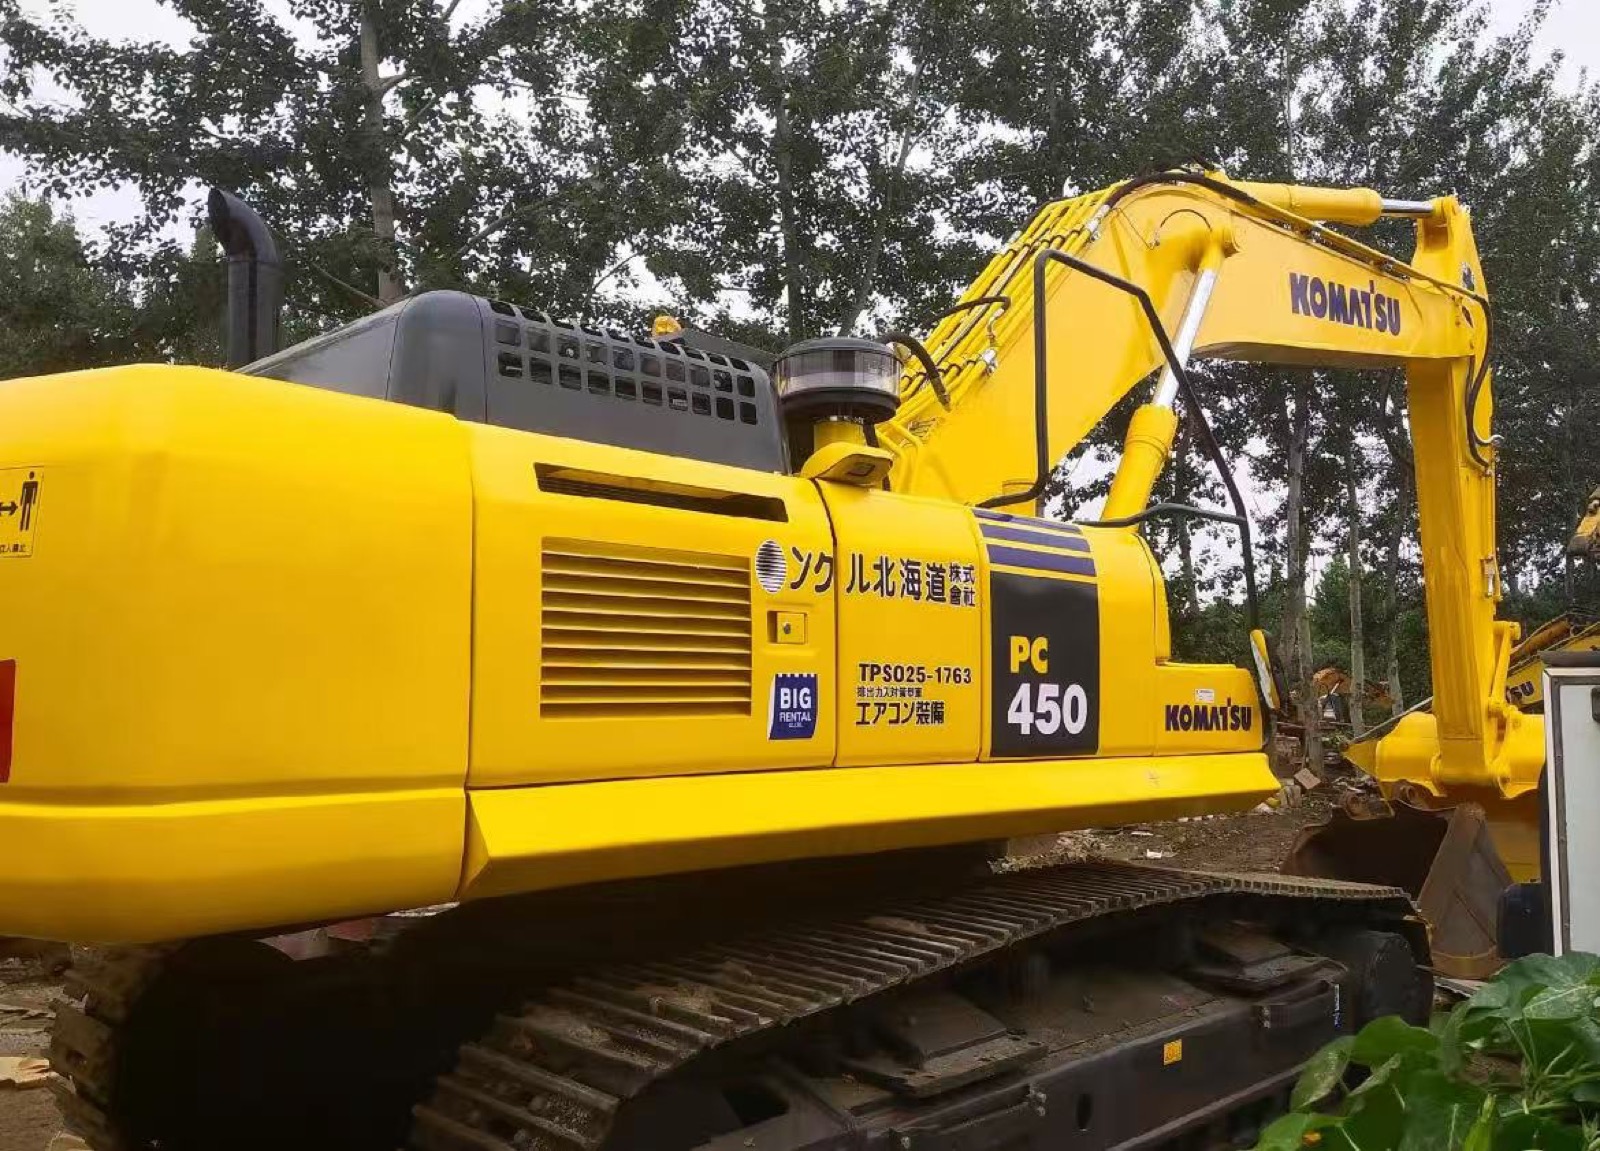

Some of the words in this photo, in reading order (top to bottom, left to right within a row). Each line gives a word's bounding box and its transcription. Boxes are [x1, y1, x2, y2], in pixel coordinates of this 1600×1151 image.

[1289, 273, 1401, 336] KOMATSU
[1010, 635, 1048, 674] PC
[780, 687, 812, 709] BIG
[856, 701, 944, 725] エアコン装備
[1007, 683, 1088, 735] 450
[1165, 697, 1252, 731] KOMATSU
[779, 711, 812, 723] RENTAL
